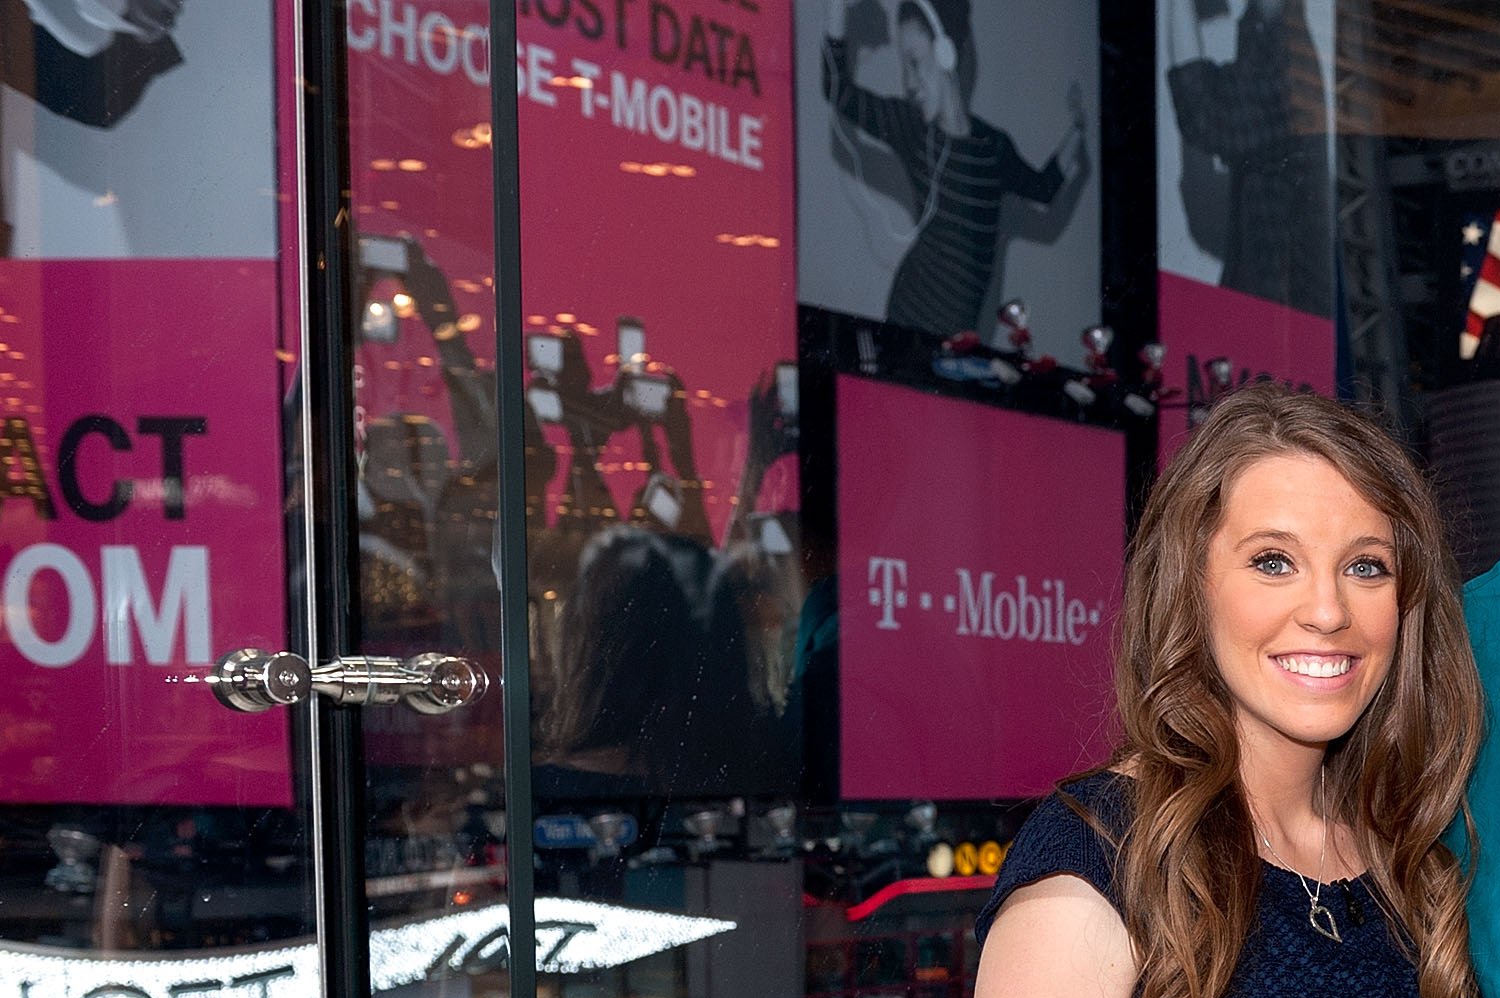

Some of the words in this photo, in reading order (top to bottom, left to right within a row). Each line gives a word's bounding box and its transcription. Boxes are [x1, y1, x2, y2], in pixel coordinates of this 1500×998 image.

[519, 0, 634, 49] OST
[651, 3, 761, 96] DATA
[573, 58, 765, 171] T-MOBILE
[0, 414, 208, 522] ACT
[2, 542, 213, 668] OM
